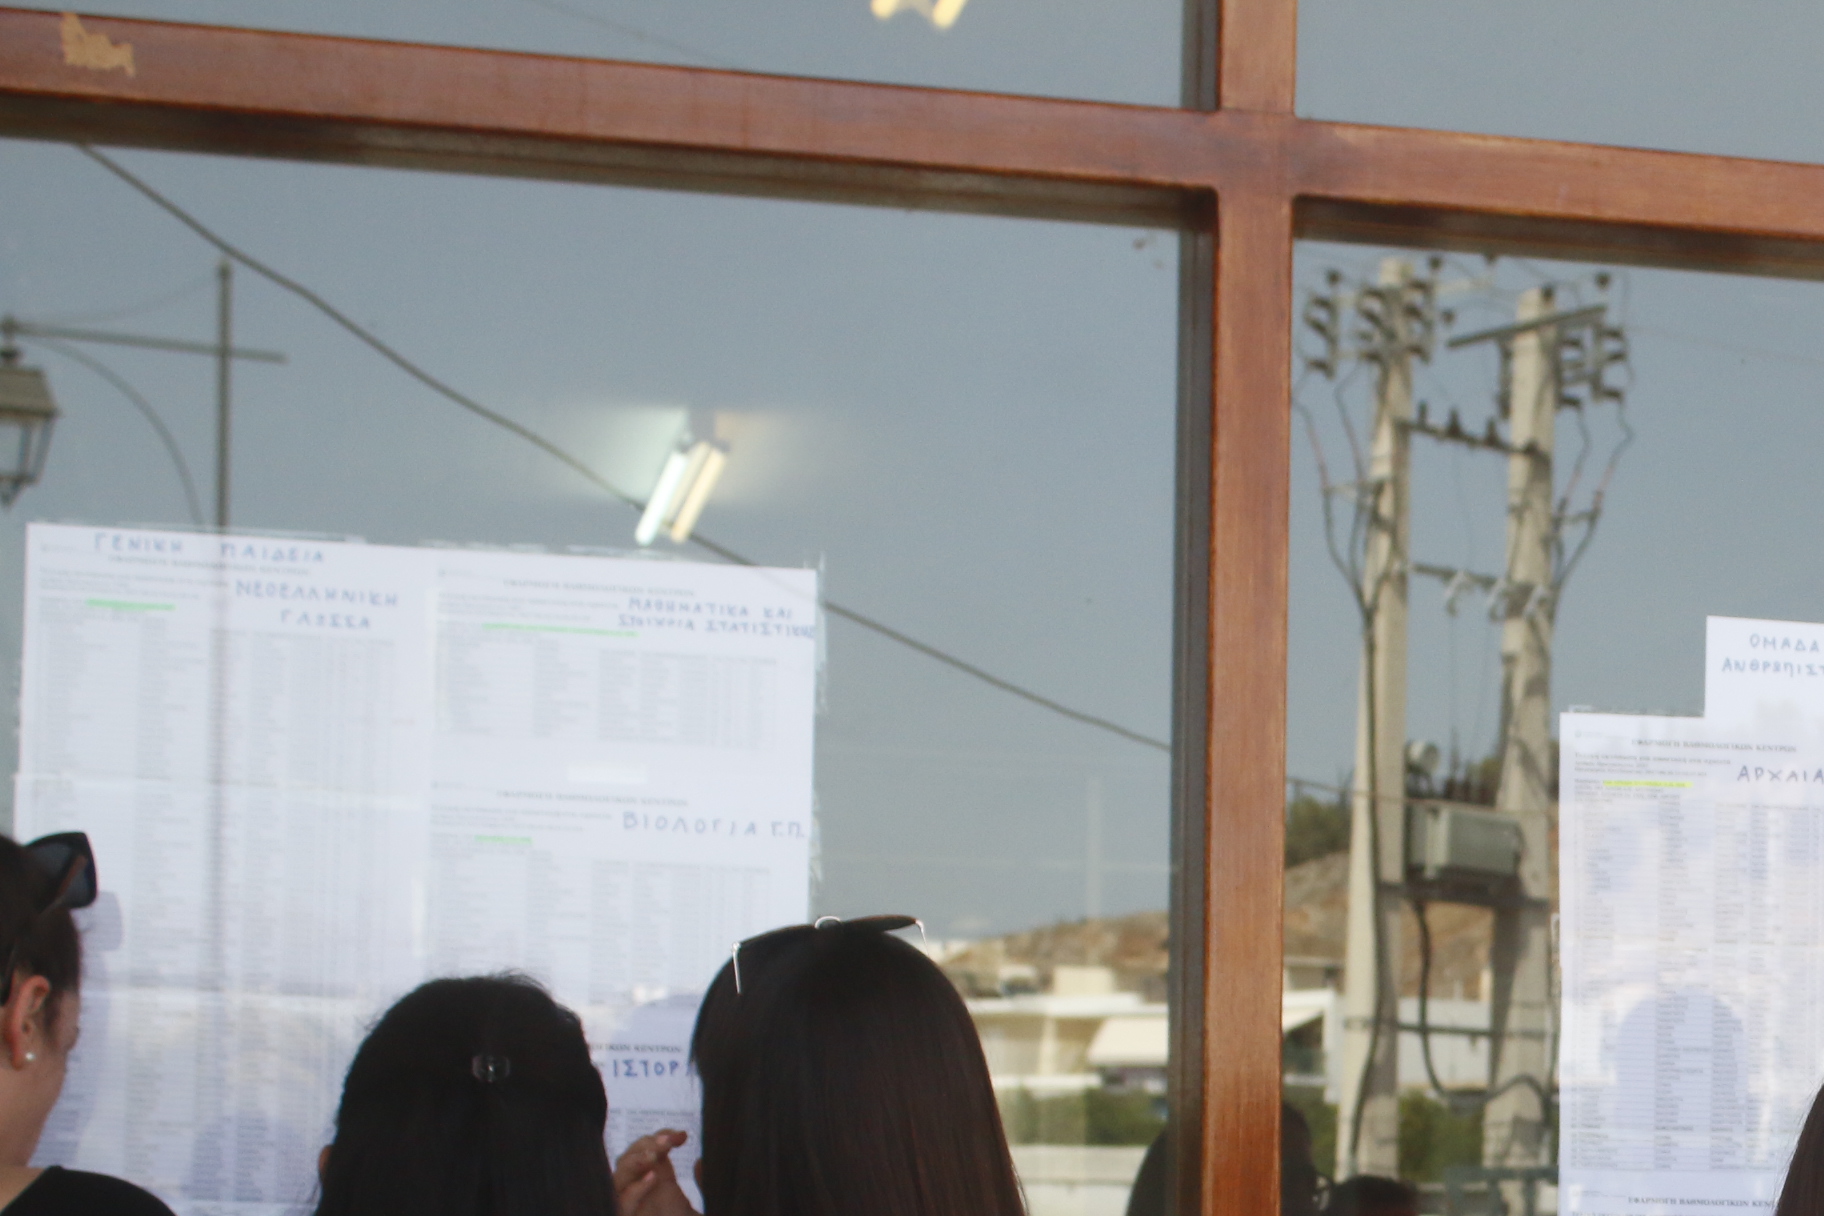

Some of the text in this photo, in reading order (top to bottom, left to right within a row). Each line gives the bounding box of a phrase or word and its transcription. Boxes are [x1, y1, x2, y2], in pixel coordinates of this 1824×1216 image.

[94, 532, 325, 563] ΓΕΝΙΚΗ ΠΑΙΔΕΙΑ
[235, 579, 399, 607] ΝΕΟΕΛΛΗΝΙΚΗ
[628, 596, 750, 616] ΜΑΘΗΜΑΤΙΚΑ
[763, 606, 793, 620] ΚΑΙ
[1749, 633, 1820, 653] ΟΜΑΔΑ
[622, 811, 757, 836] ΒΙΟΛΟΓΙΑ
